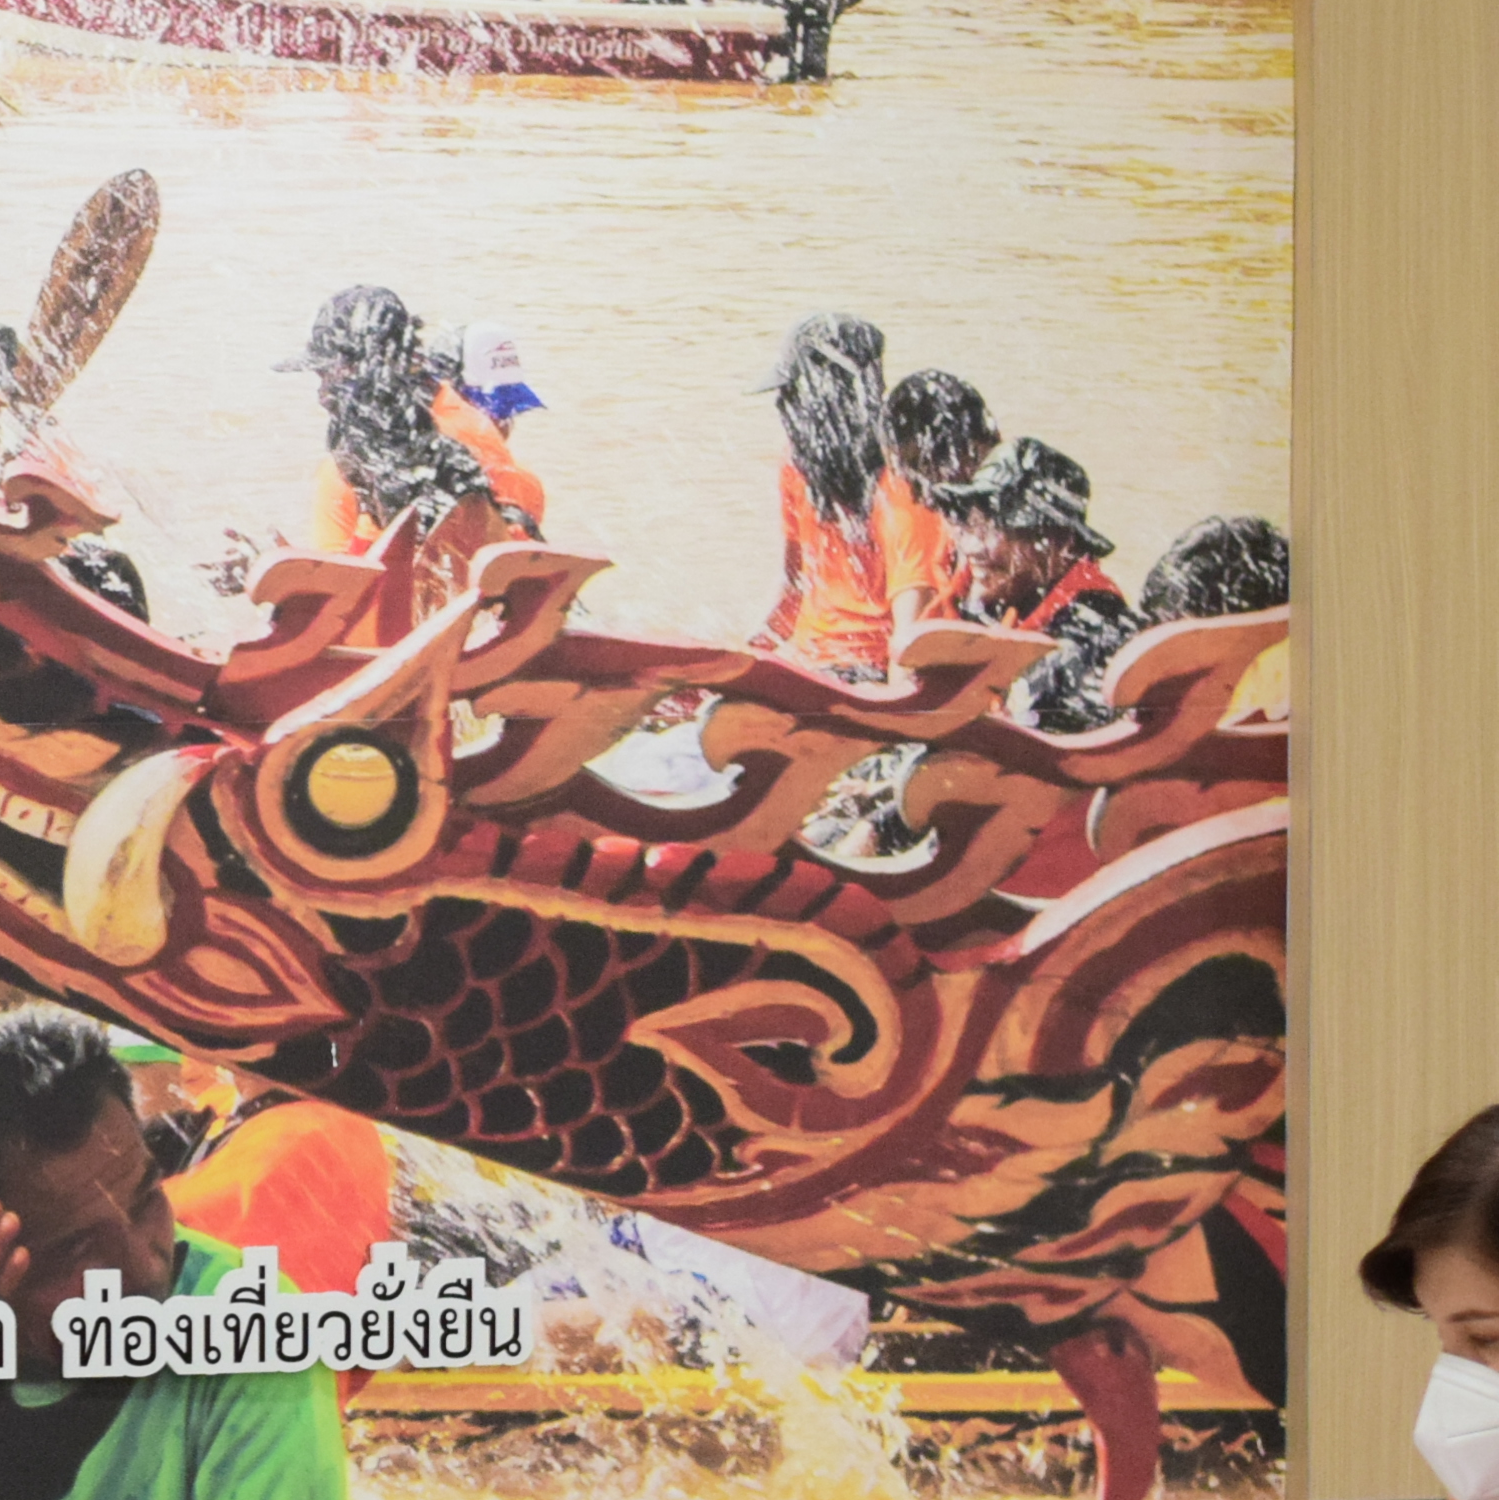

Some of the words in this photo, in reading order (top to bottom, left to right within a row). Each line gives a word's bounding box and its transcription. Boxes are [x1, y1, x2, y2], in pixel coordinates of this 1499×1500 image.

[69, 1262, 522, 1368] ท่องเที่ยวยั่งยืน
